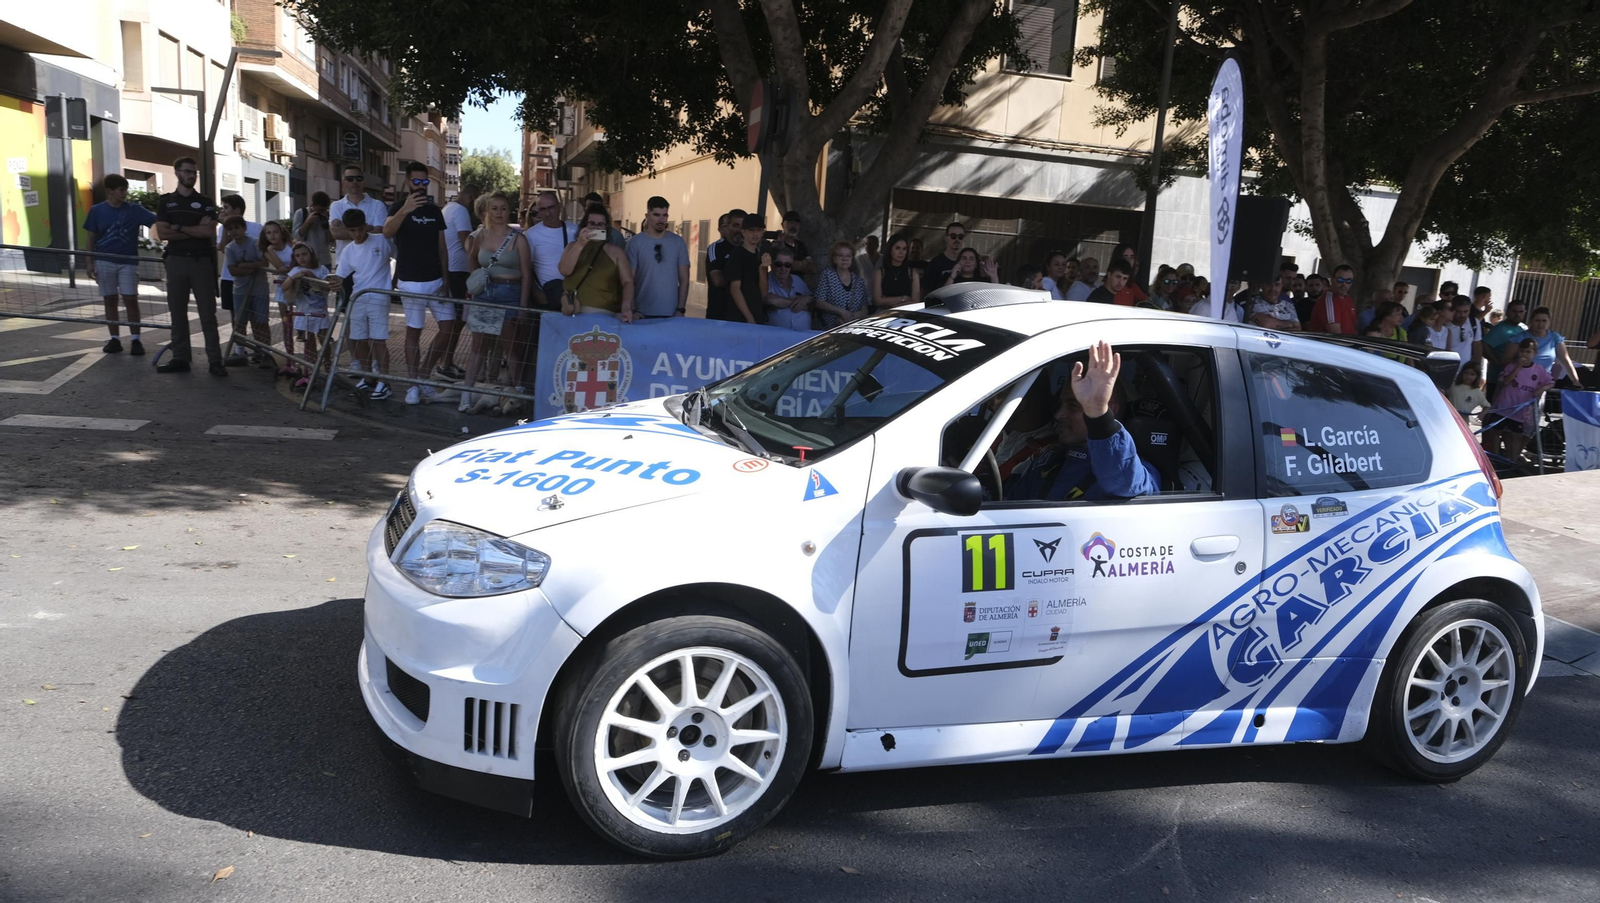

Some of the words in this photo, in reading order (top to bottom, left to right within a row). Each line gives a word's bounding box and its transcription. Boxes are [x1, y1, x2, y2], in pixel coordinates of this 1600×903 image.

[1150, 434, 1168, 443] OMP
[436, 448, 537, 466] Fiat
[536, 449, 701, 486] Punto
[1285, 455, 1302, 477] F.
[1307, 451, 1383, 476] Gilabert
[454, 468, 596, 496] S-1600
[1119, 546, 1157, 558] COSTA
[1159, 545, 1174, 556] DE
[965, 534, 1006, 591] 11
[1107, 557, 1175, 578] ALMERÍA
[1212, 484, 1459, 651] AGRO-MECANICA
[1022, 568, 1075, 578] CUPRA
[1227, 497, 1478, 687] GARCIA
[979, 605, 1021, 614] DIPUTACIÓN
[1046, 597, 1087, 608] ALMERÍA
[988, 612, 1019, 621] ALMERÍA
[1045, 608, 1067, 616] CIUDAD
